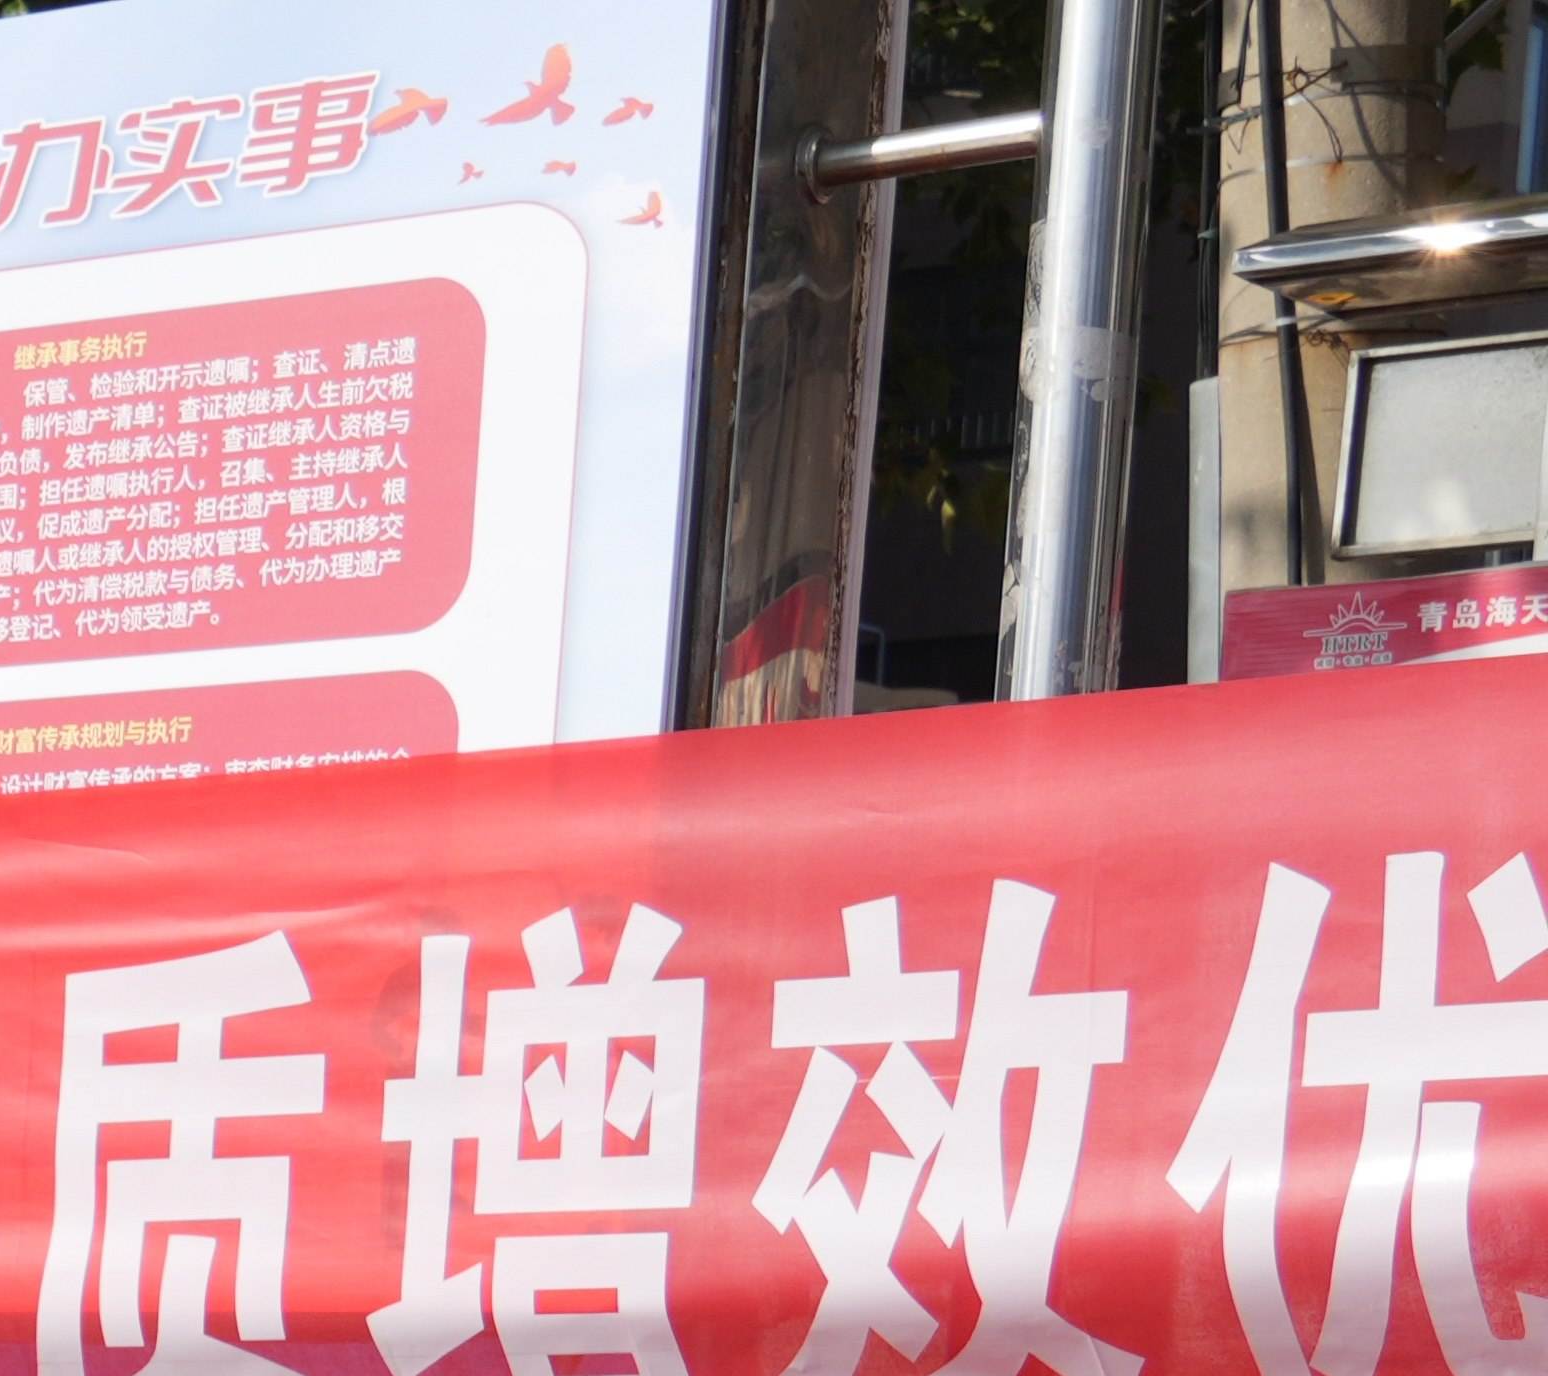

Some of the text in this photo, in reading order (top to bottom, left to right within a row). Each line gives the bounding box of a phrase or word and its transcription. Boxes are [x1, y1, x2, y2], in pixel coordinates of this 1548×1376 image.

[13, 332, 147, 371] 继承事务执行
[1417, 594, 1548, 633] 青岛海天
